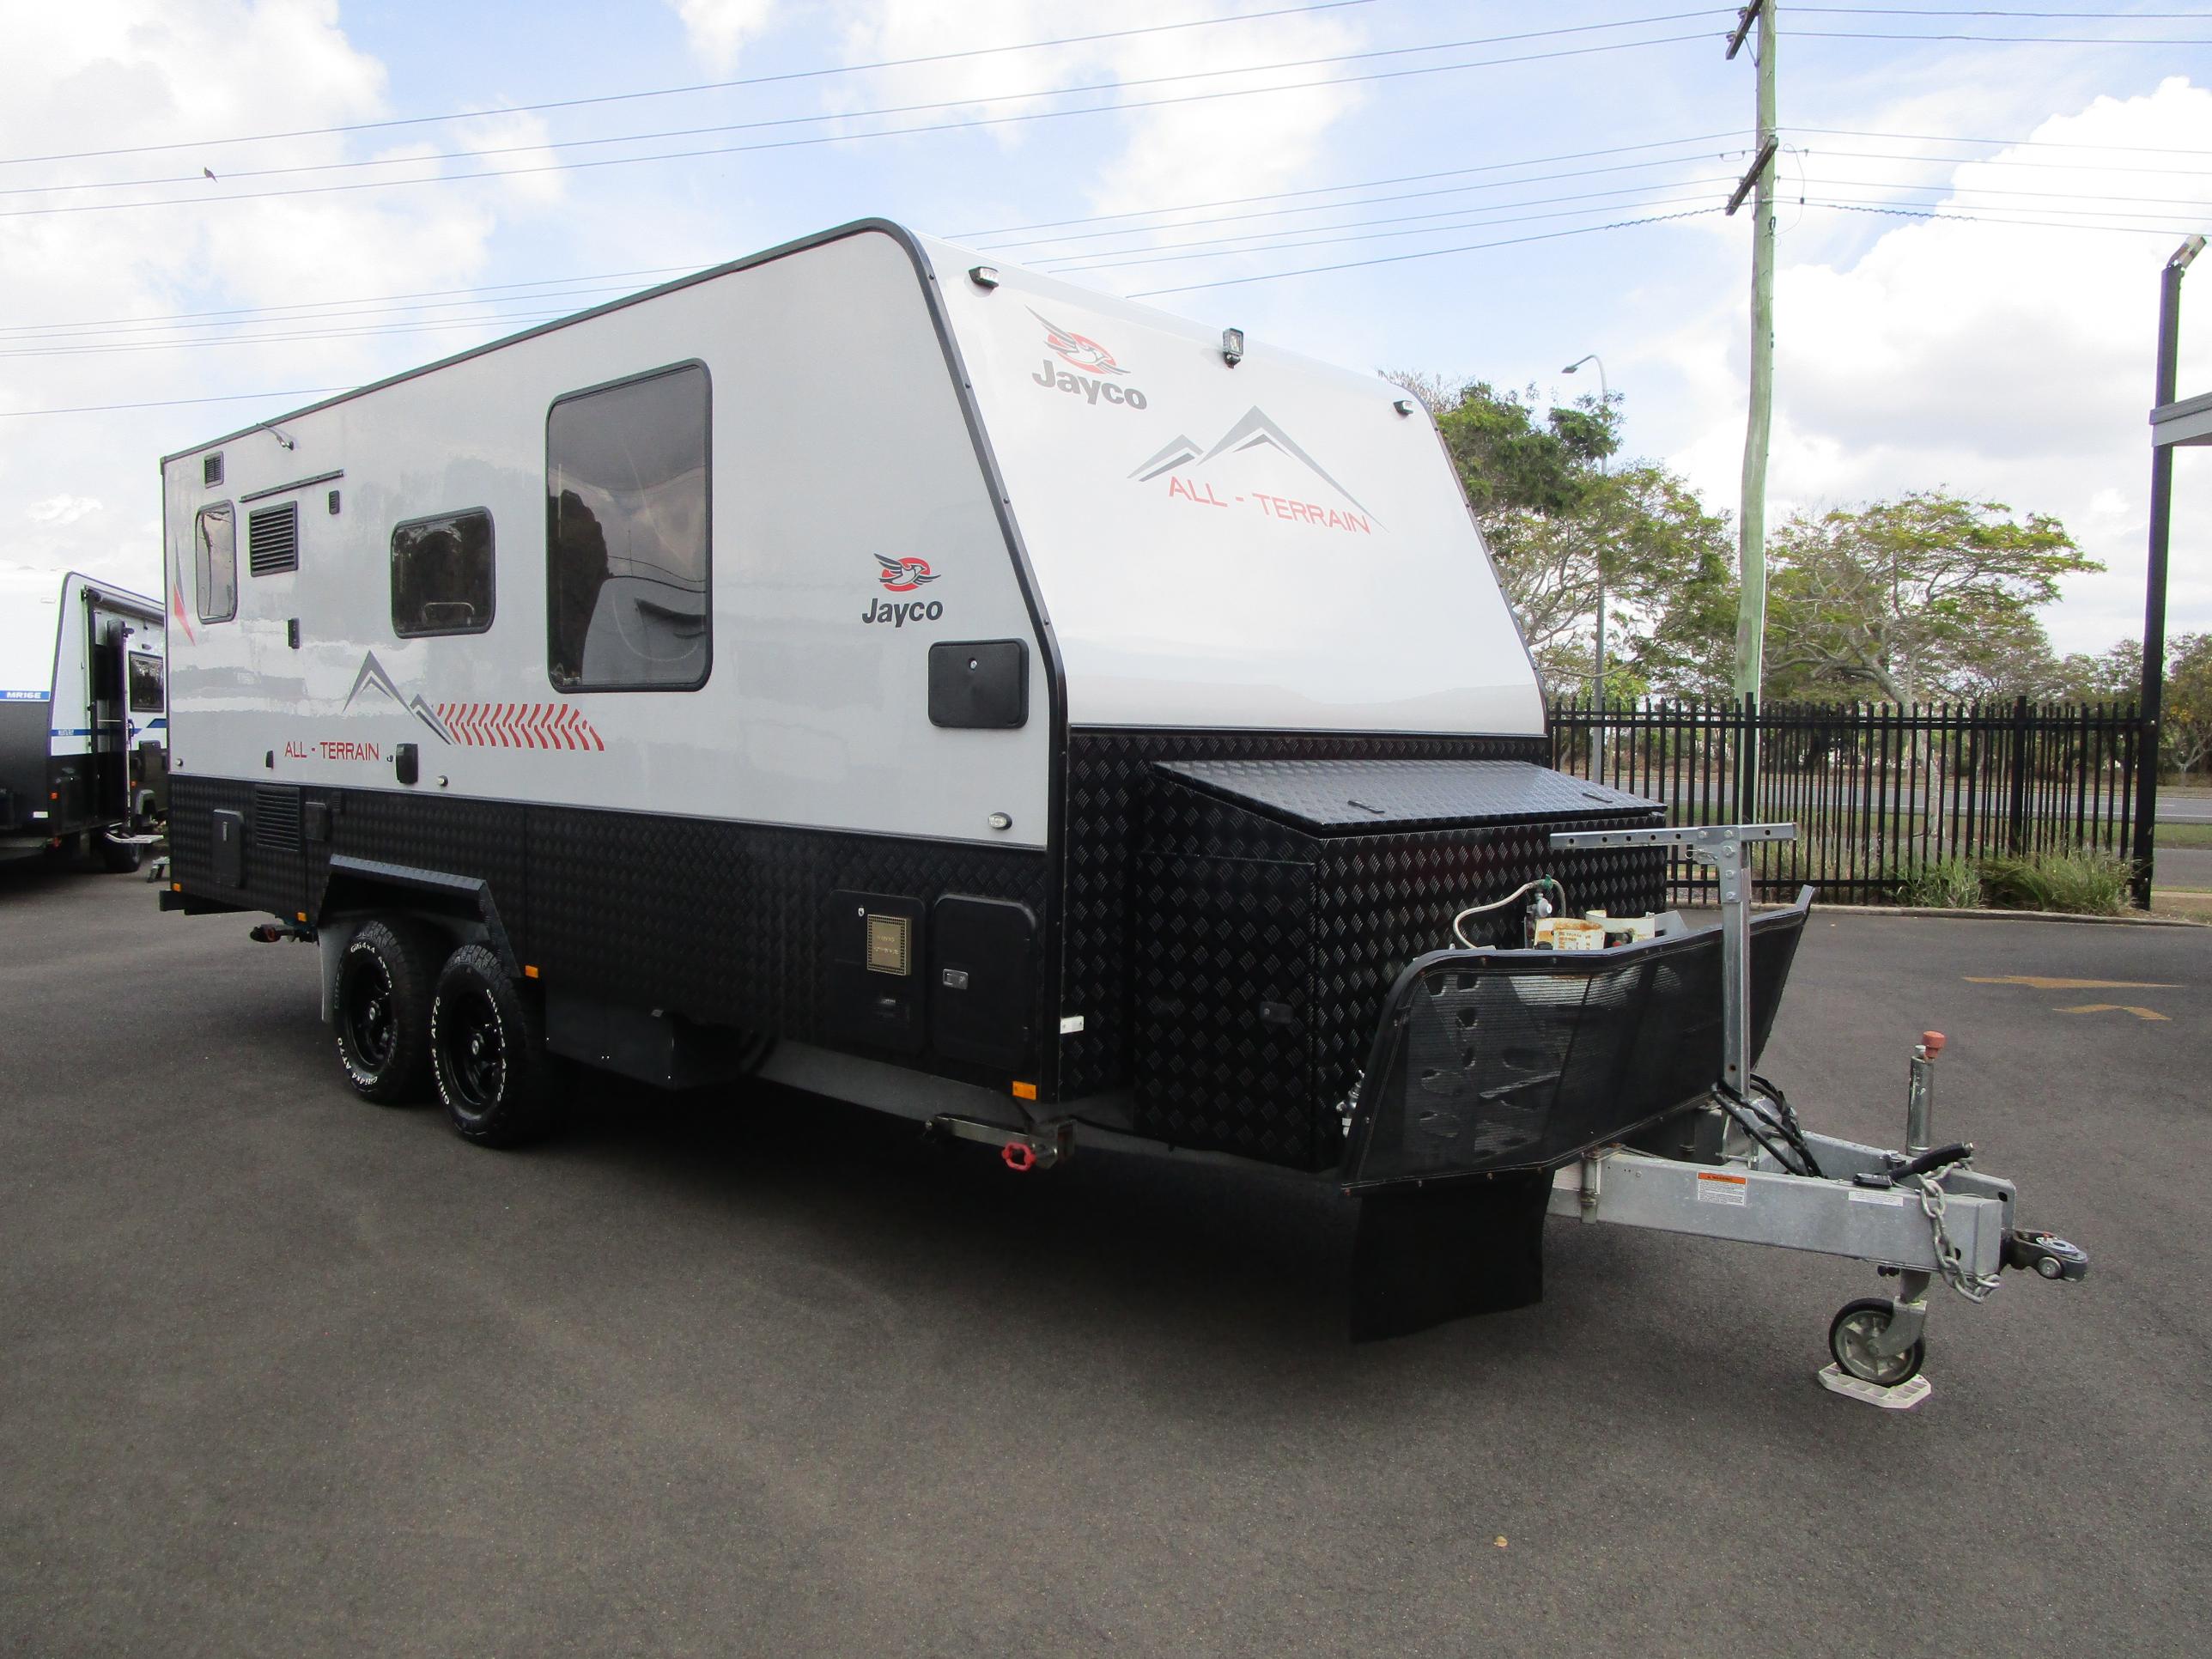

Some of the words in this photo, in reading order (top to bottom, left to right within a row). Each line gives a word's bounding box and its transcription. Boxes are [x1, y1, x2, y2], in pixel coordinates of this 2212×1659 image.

[1032, 359, 1147, 410] Jayco
[1169, 476, 1228, 507] ALL
[1252, 492, 1370, 535] TERRAIN
[861, 598, 944, 628] Jayco
[284, 741, 307, 757] ALL
[319, 742, 380, 761] TERRAIN
